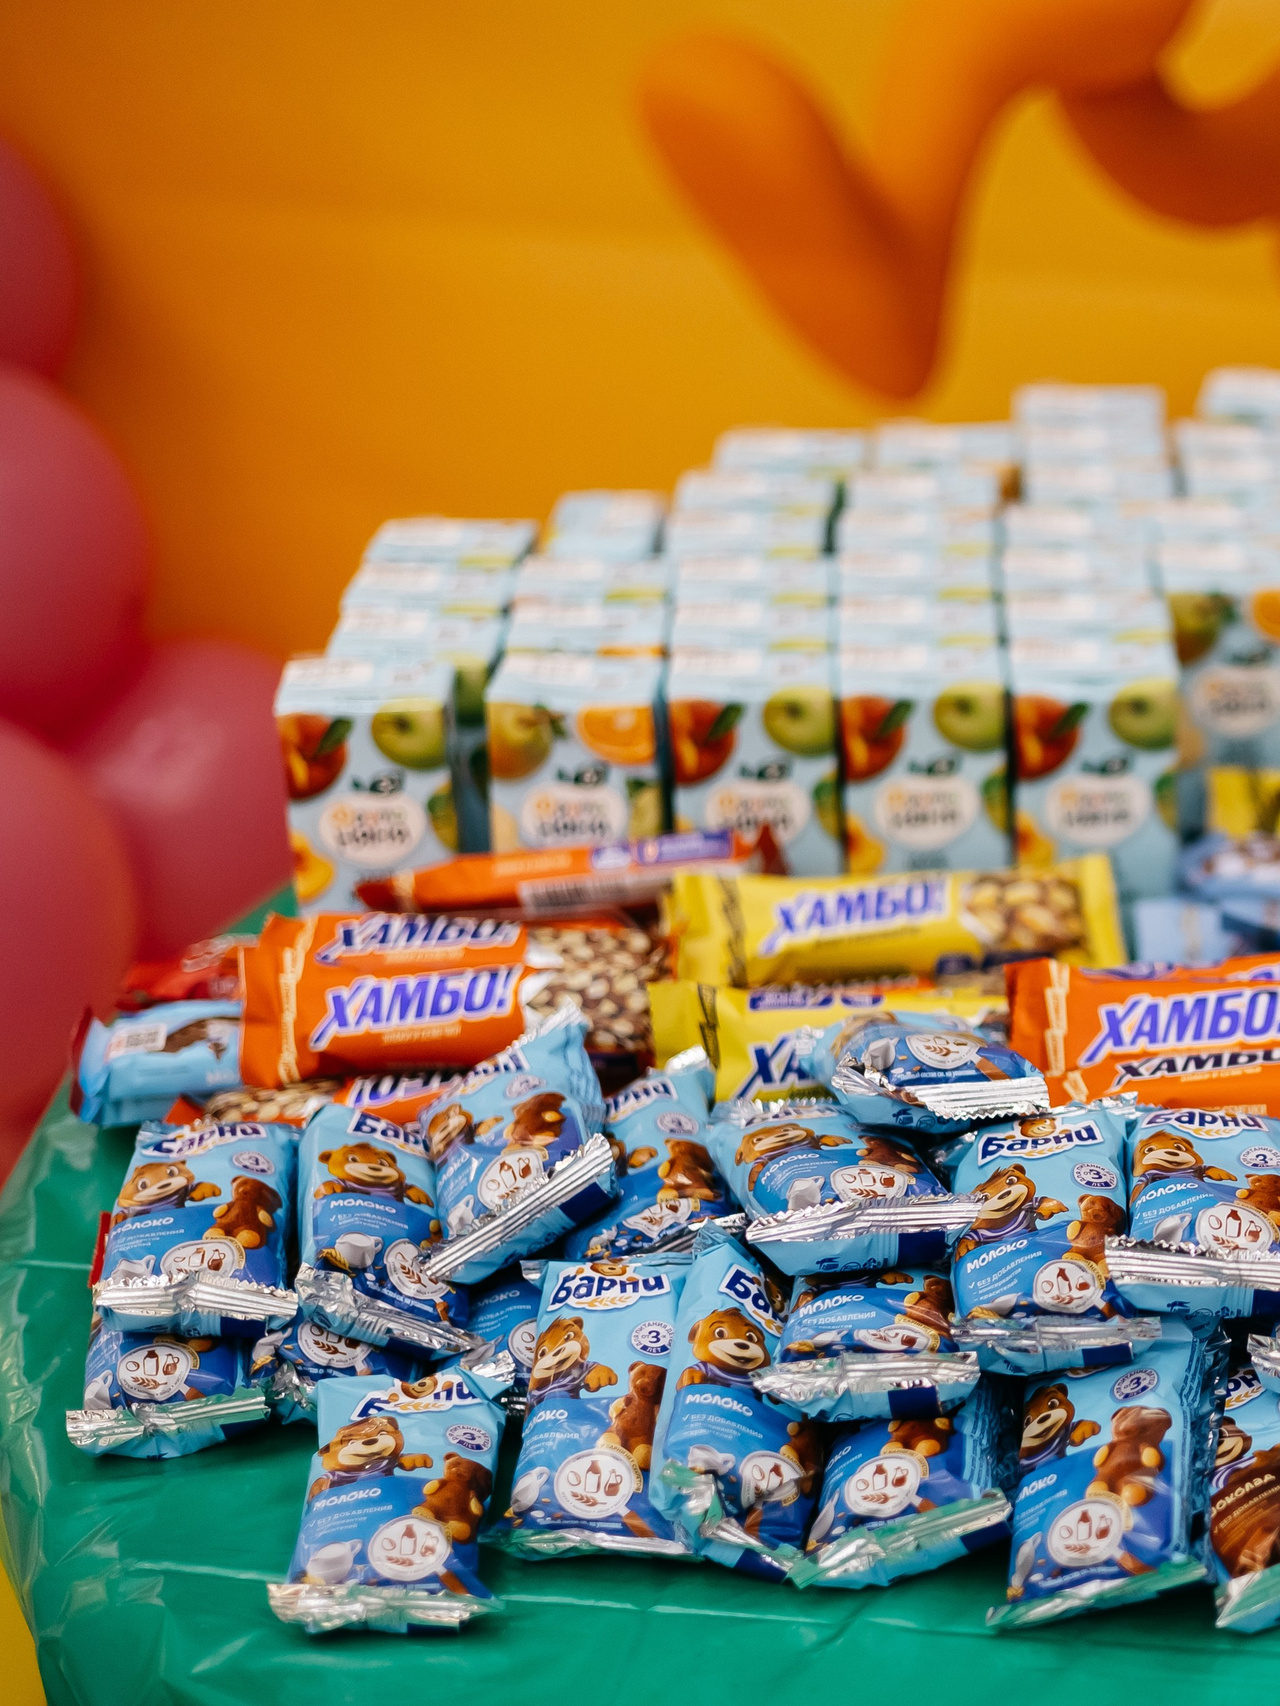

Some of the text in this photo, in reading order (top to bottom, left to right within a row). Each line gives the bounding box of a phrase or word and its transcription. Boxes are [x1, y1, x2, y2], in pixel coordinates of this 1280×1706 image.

[310, 970, 519, 1048] ХАМБО!
[1146, 1109, 1264, 1131] Барни
[980, 1125, 1098, 1160] Барни
[762, 1153, 820, 1184] МОЛОКО
[330, 1198, 396, 1214] МОЛОКО
[1135, 1182, 1198, 1208] МОЛОКО
[1142, 1209, 1157, 1219] БЕЗ
[967, 1239, 1029, 1273] МОЛОКО
[976, 1251, 1043, 1288] БЕЗ ДОБАВЛЕНИЯ
[552, 1273, 667, 1306] Барни
[800, 1294, 864, 1318] МОЛОКО
[818, 1311, 876, 1325] ДОБАВЛЕНИЯ
[686, 1393, 754, 1416] МОЛОКО
[707, 1415, 763, 1439] ДОБАВЛЕНИЯ
[1018, 1474, 1057, 1500] ЛОКО
[314, 1488, 381, 1511] МОЛОКО
[333, 1505, 393, 1520] ДОБАВЛЕНИЯ
